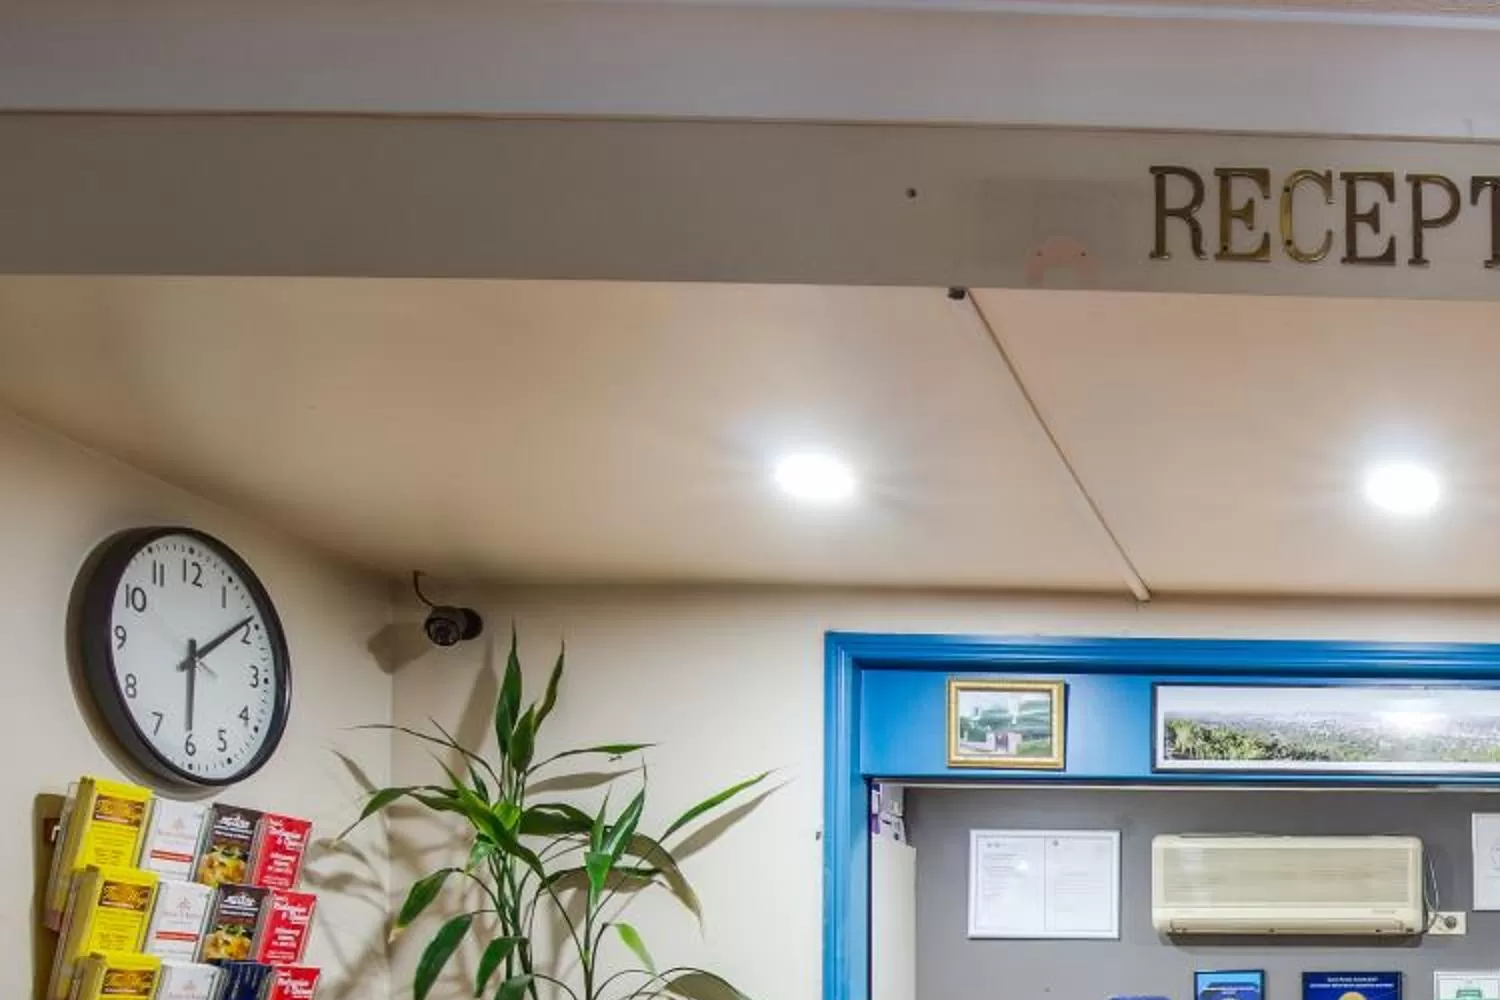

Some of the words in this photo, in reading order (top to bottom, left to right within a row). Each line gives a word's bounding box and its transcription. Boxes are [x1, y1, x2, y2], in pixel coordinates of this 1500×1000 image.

[152, 559, 165, 588] 11
[182, 558, 203, 588] 12
[125, 583, 148, 613] 10
[222, 585, 228, 609] 1
[113, 625, 127, 650] 9
[240, 623, 252, 645] 2
[124, 673, 137, 699] 8
[249, 665, 260, 689] 3
[151, 711, 164, 736] 7
[239, 705, 250, 727] 4
[184, 733, 197, 757] 6
[216, 729, 228, 753] 5
